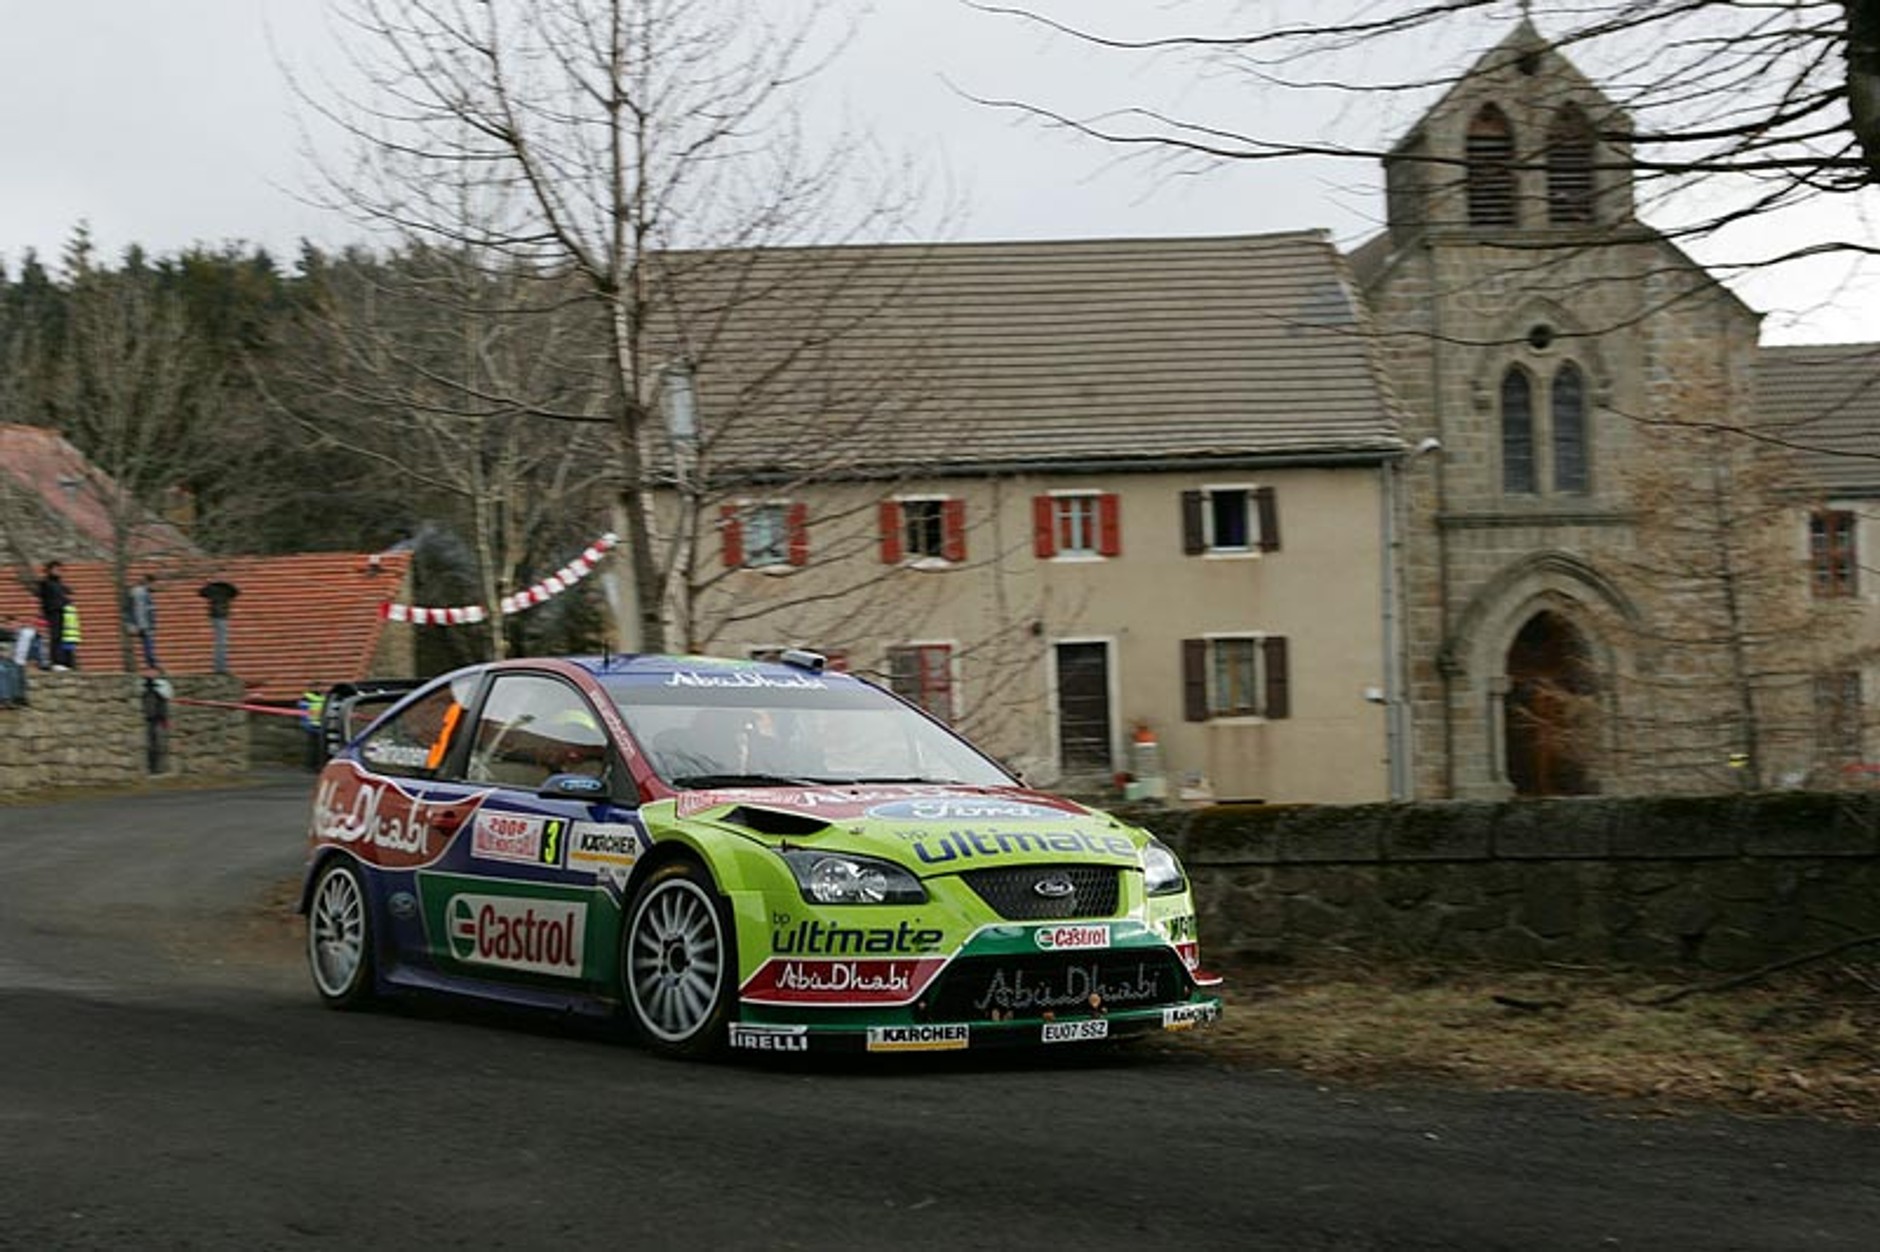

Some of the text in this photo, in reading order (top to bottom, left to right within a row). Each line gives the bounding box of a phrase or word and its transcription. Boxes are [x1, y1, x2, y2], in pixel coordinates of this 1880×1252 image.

[544, 820, 560, 865] 3
[913, 829, 1139, 865] ultimate
[478, 904, 576, 967] Castrol
[771, 919, 943, 953] ultimate
[1054, 928, 1107, 946] Castrol
[728, 1022, 808, 1051] PIRELLI
